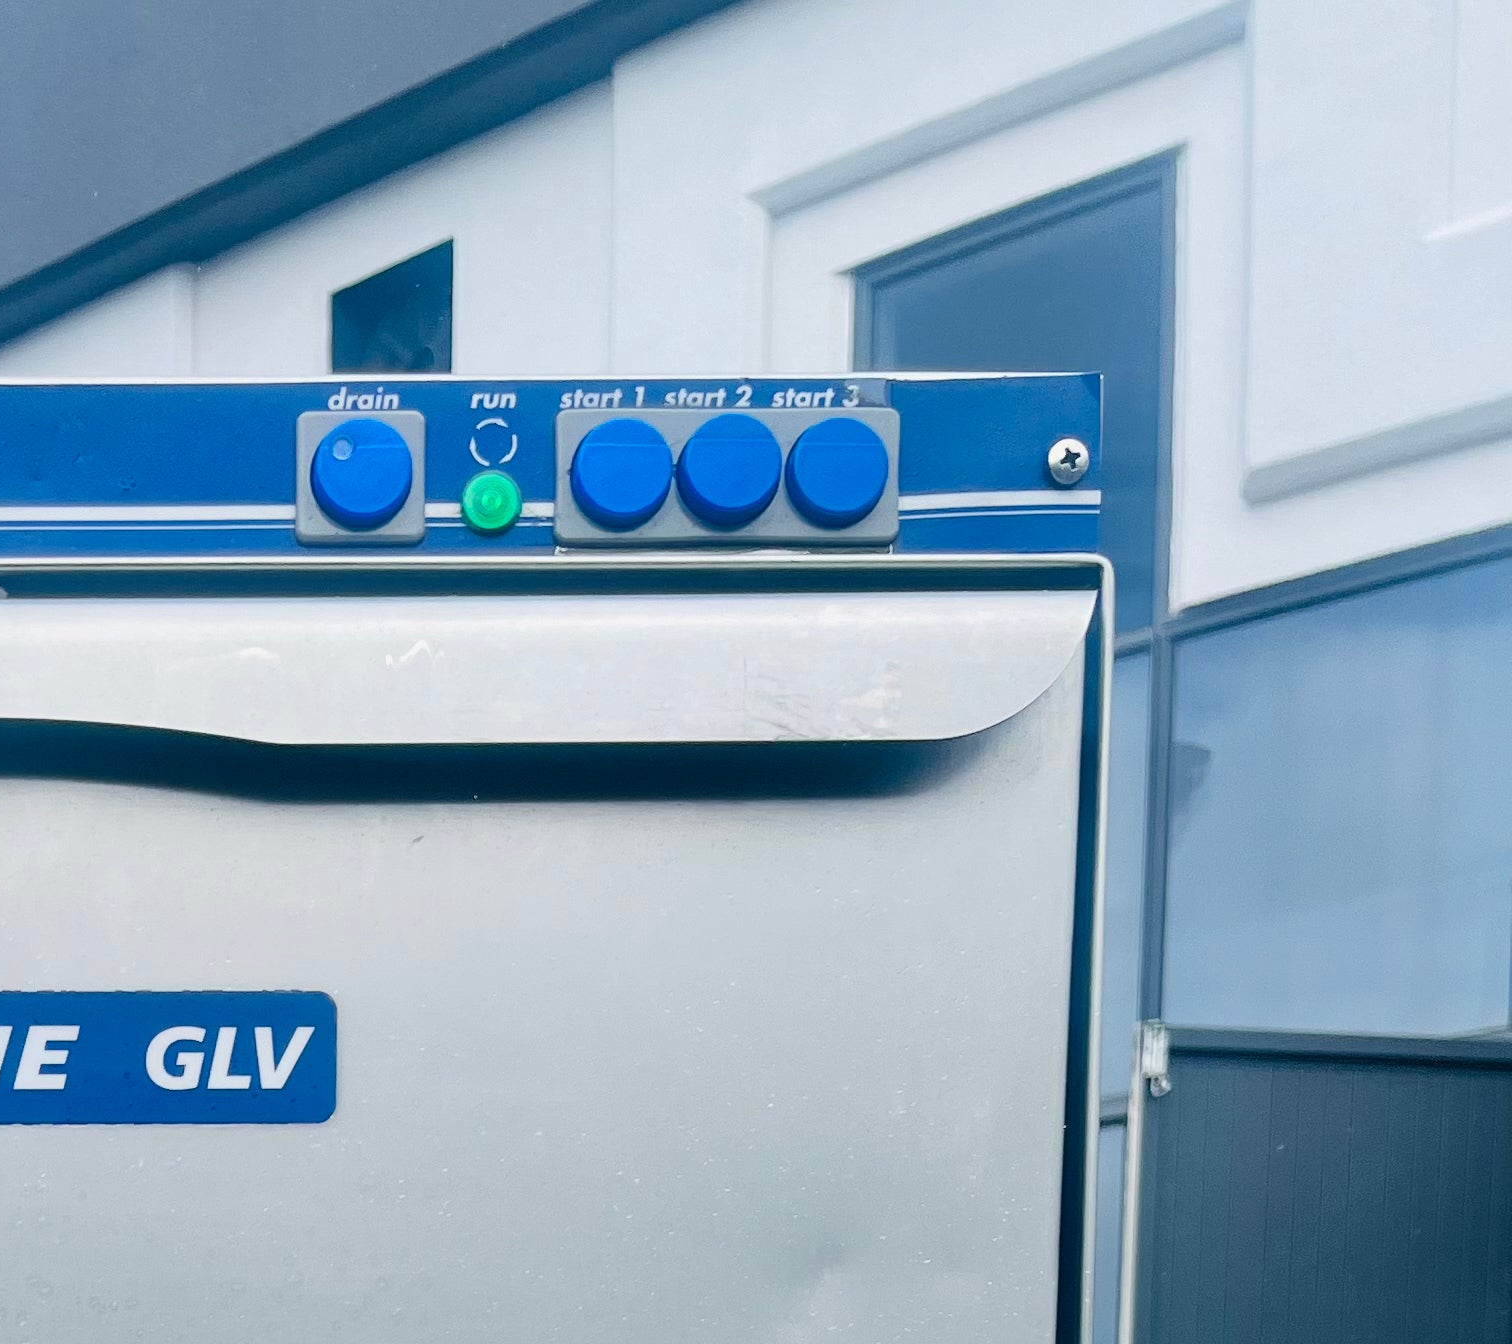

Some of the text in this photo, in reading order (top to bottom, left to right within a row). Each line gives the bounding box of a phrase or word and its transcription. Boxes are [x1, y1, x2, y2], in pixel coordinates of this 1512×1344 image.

[328, 388, 399, 410] drain
[471, 391, 516, 410] run
[560, 386, 645, 408] start 1
[664, 385, 753, 408] start 2
[772, 385, 860, 408] start 3
[144, 1025, 315, 1091] GLV
